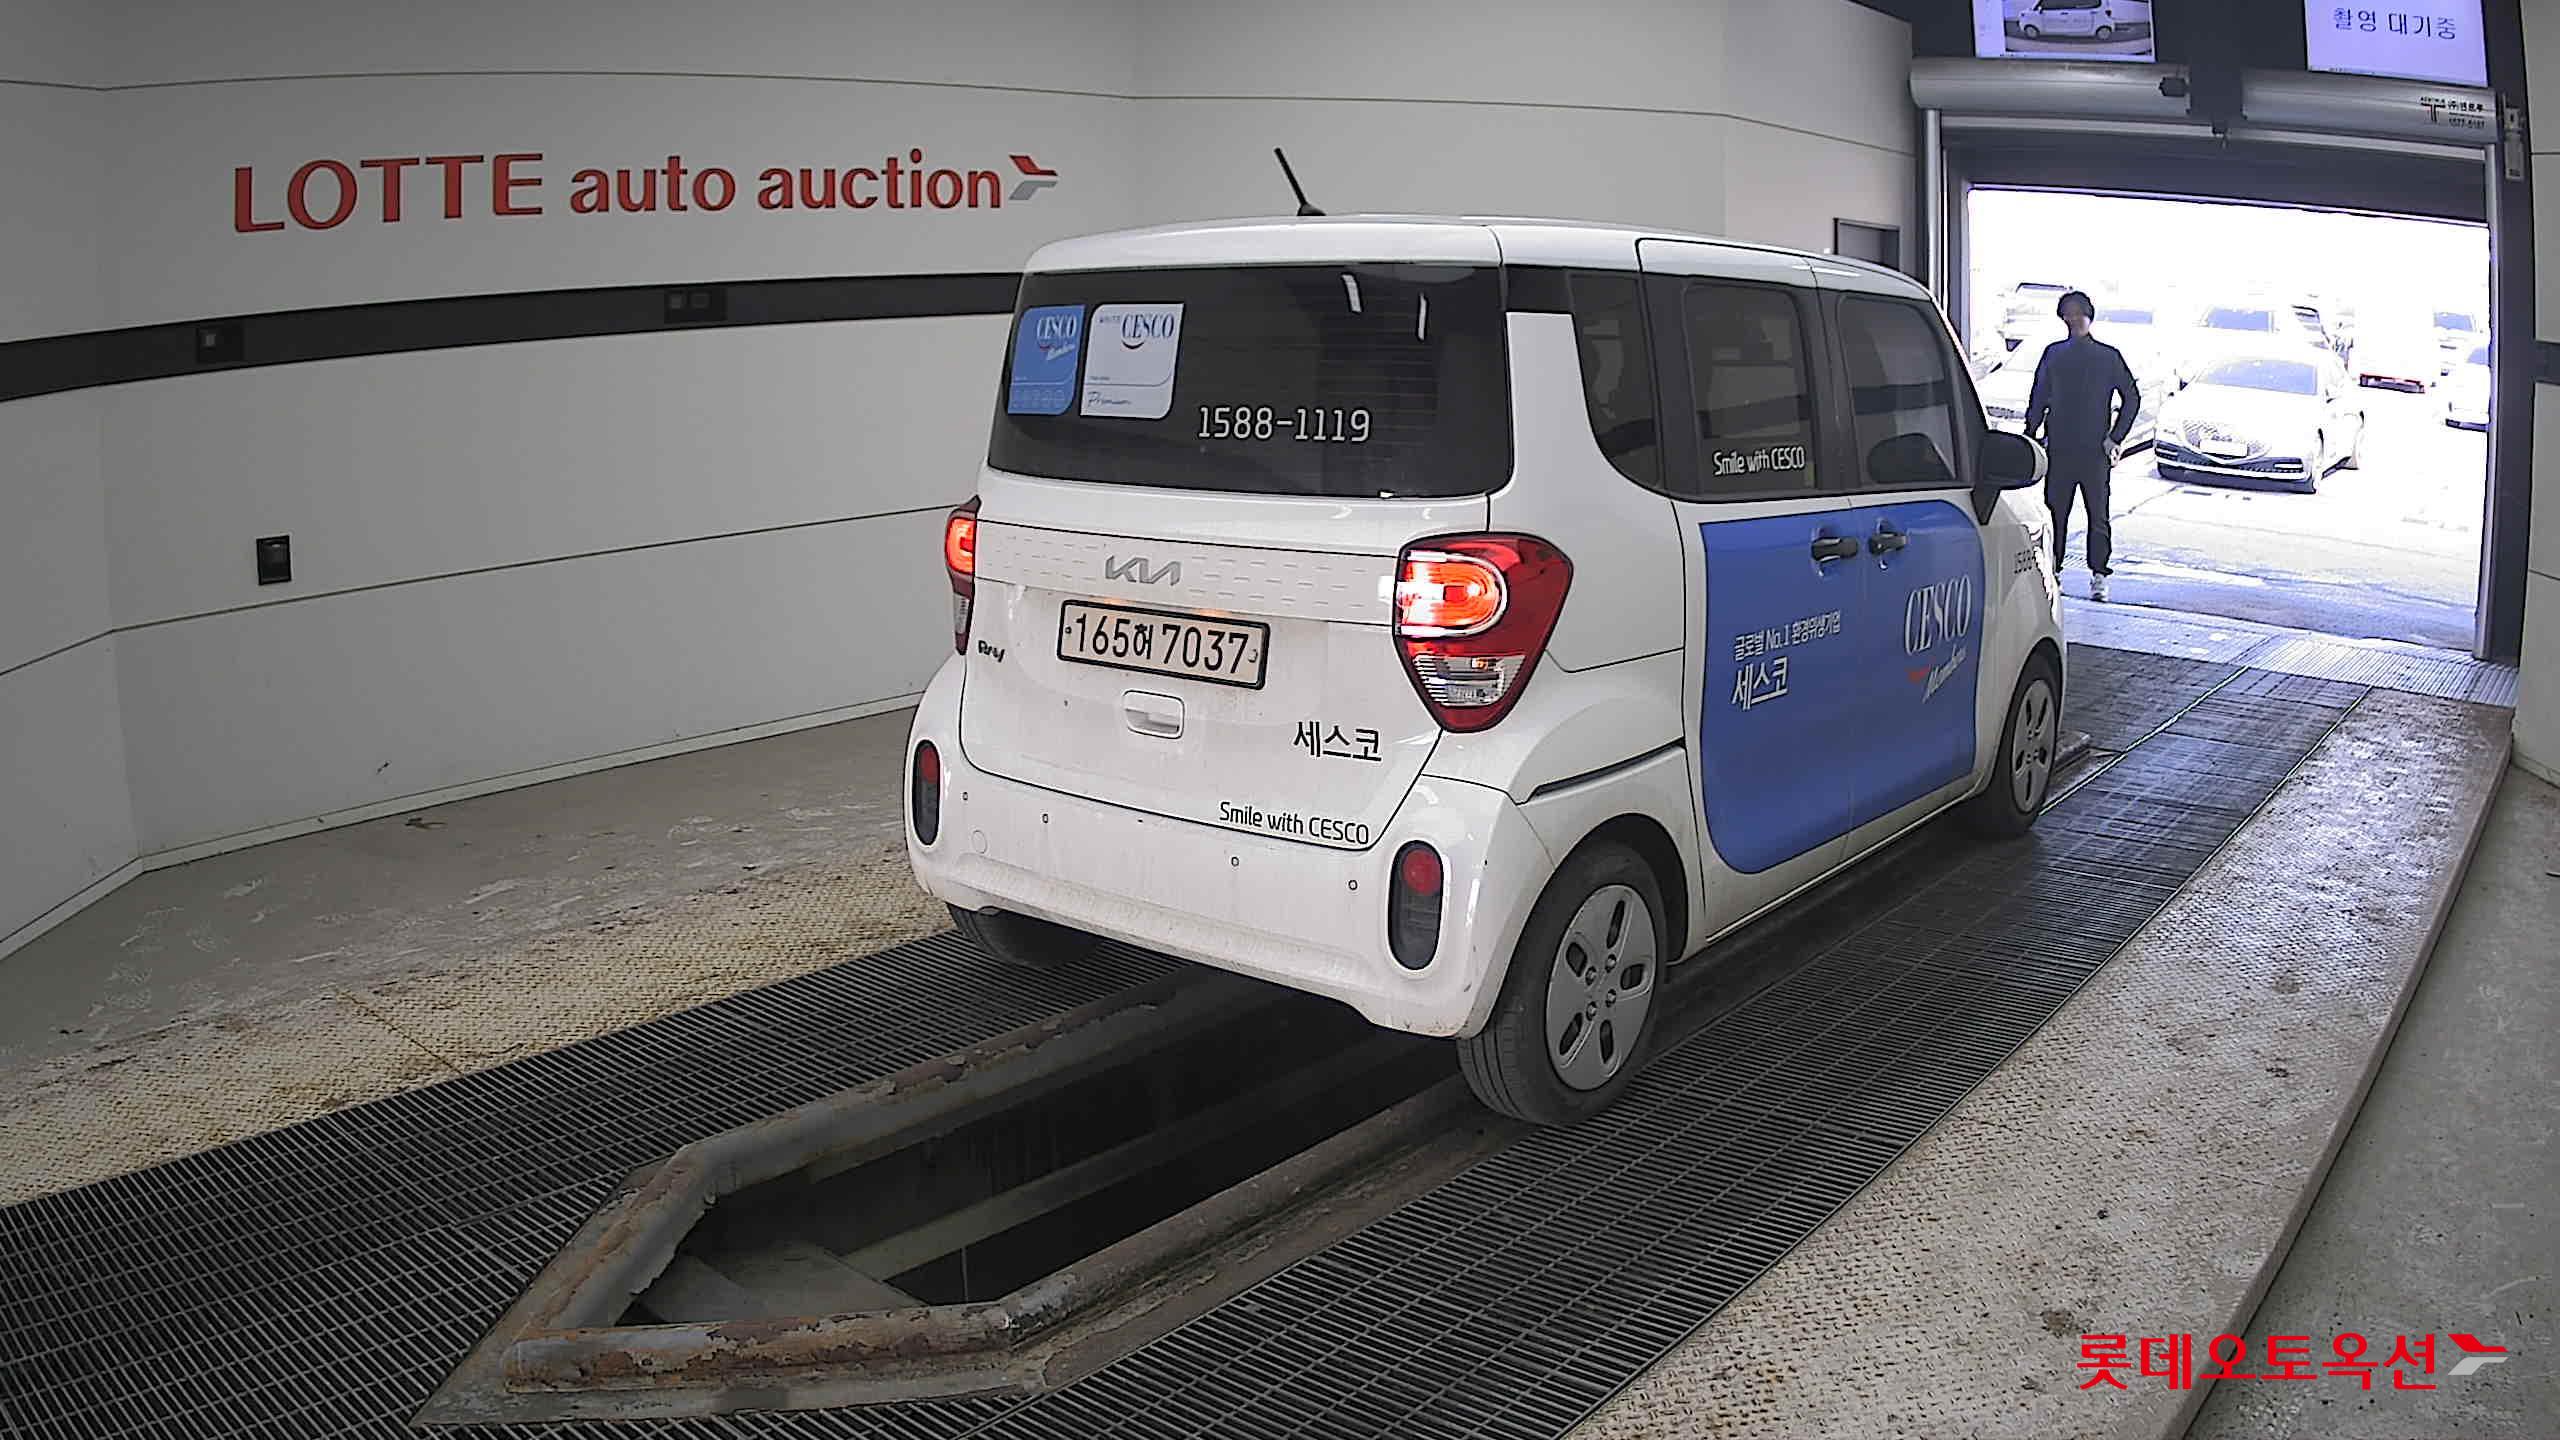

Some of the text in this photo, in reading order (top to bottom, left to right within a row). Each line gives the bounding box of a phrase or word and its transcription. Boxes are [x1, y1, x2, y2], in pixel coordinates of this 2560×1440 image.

[2388, 12, 2456, 40] 대기중
[234, 148, 1000, 233] LOTTE auto auction
[1036, 314, 1077, 339] CESCO
[1121, 312, 1175, 338] CESCO
[1198, 406, 1370, 442] 1588-1119
[1714, 446, 1805, 475] Smile with CESCO
[1905, 574, 1971, 656] CESCO
[1075, 612, 1250, 674] 165허 7037
[1734, 630, 1764, 661] 글로벌
[1731, 656, 1788, 711] 세스코
[1293, 720, 1382, 762] 세스코
[1219, 801, 1370, 846] Smile with CESCO
